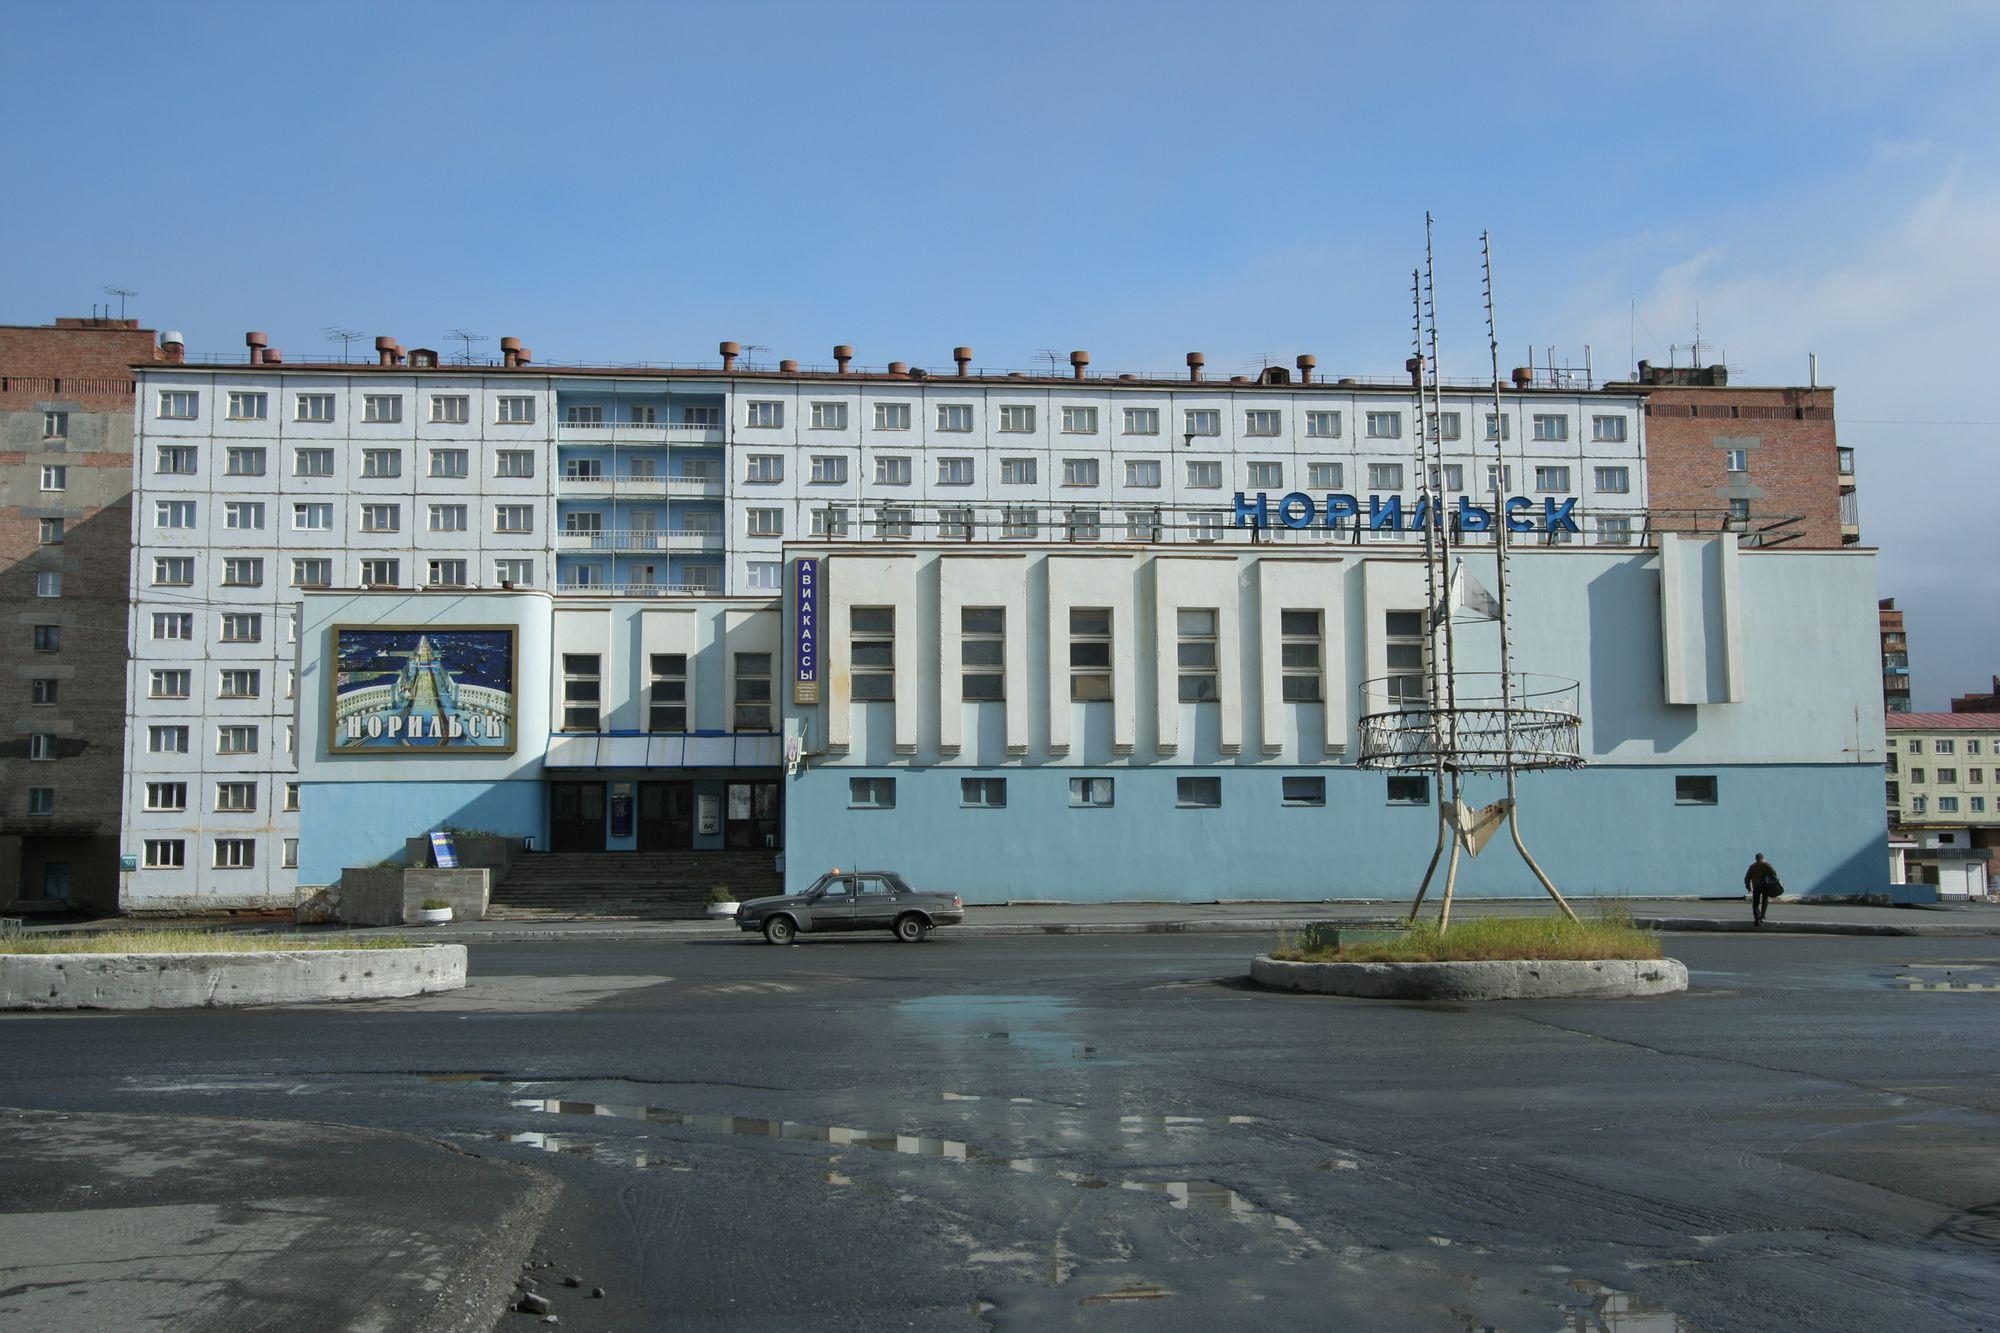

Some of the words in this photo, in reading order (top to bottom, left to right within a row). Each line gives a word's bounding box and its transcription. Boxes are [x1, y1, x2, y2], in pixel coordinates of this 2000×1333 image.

[1234, 492, 1580, 533] НОРИЛЬСК
[800, 561, 813, 680] АВИАКАССЫ
[347, 714, 505, 739] НОРИЛЬСК
